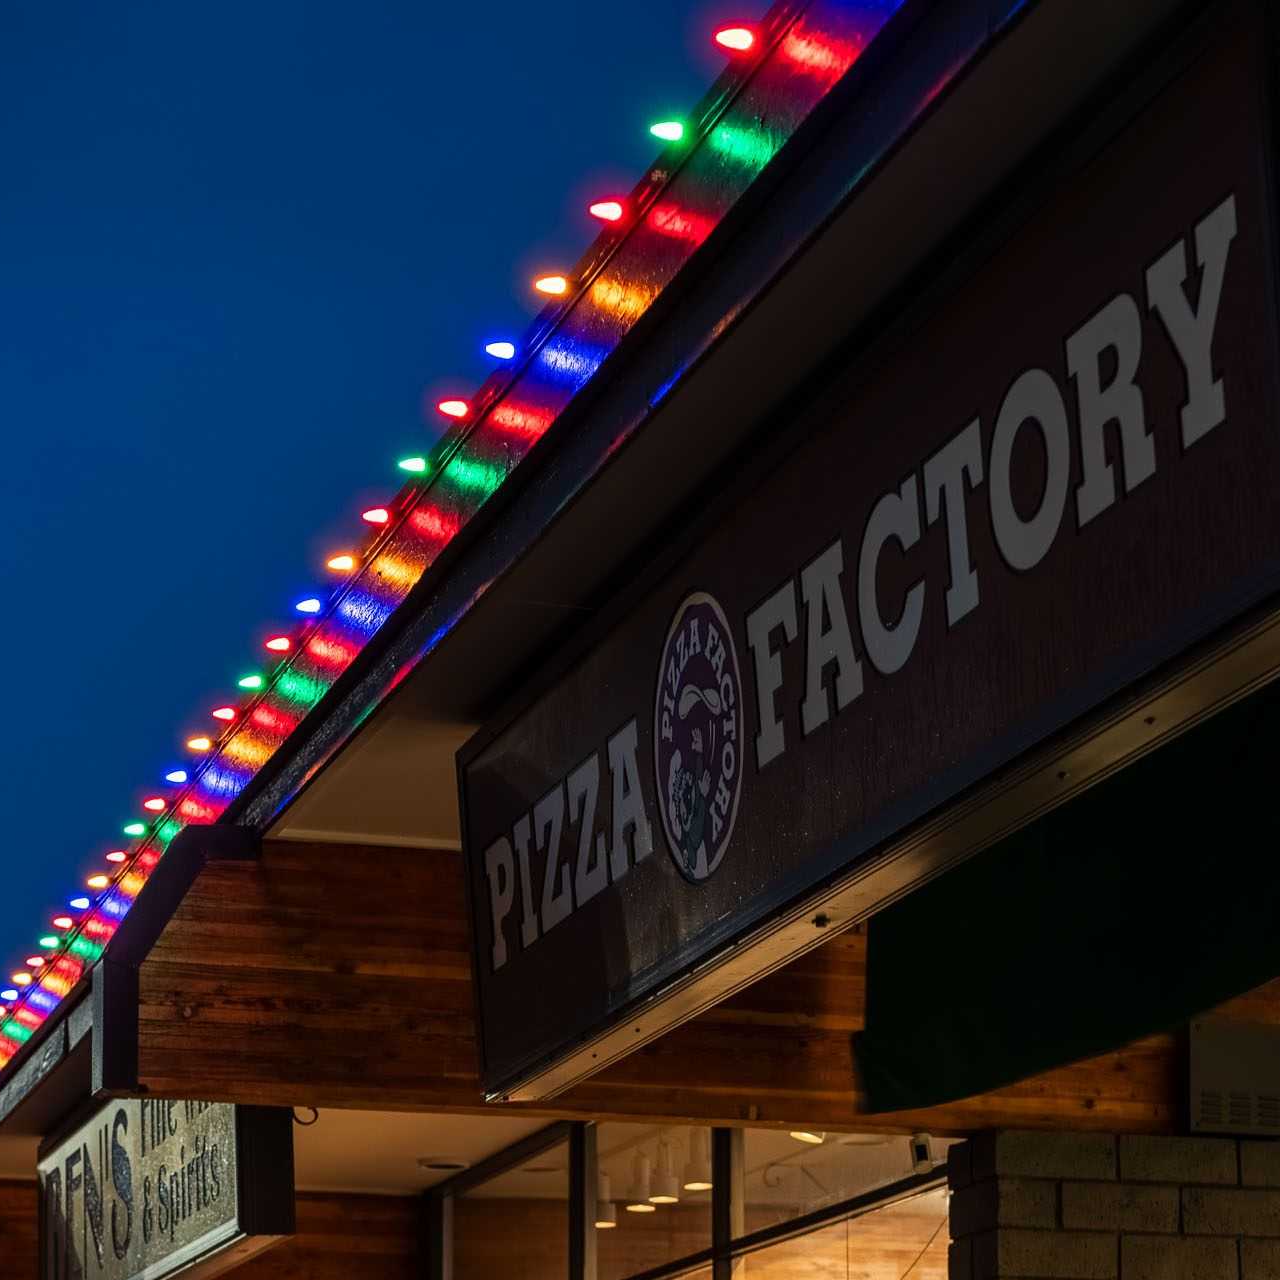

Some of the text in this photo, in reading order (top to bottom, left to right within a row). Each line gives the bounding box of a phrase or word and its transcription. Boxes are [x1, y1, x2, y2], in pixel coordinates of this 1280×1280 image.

[484, 195, 1237, 971] PIZZA FACTORY
[661, 617, 736, 843] PIZZA FACTORY
[143, 1135, 220, 1244] & Spirits
